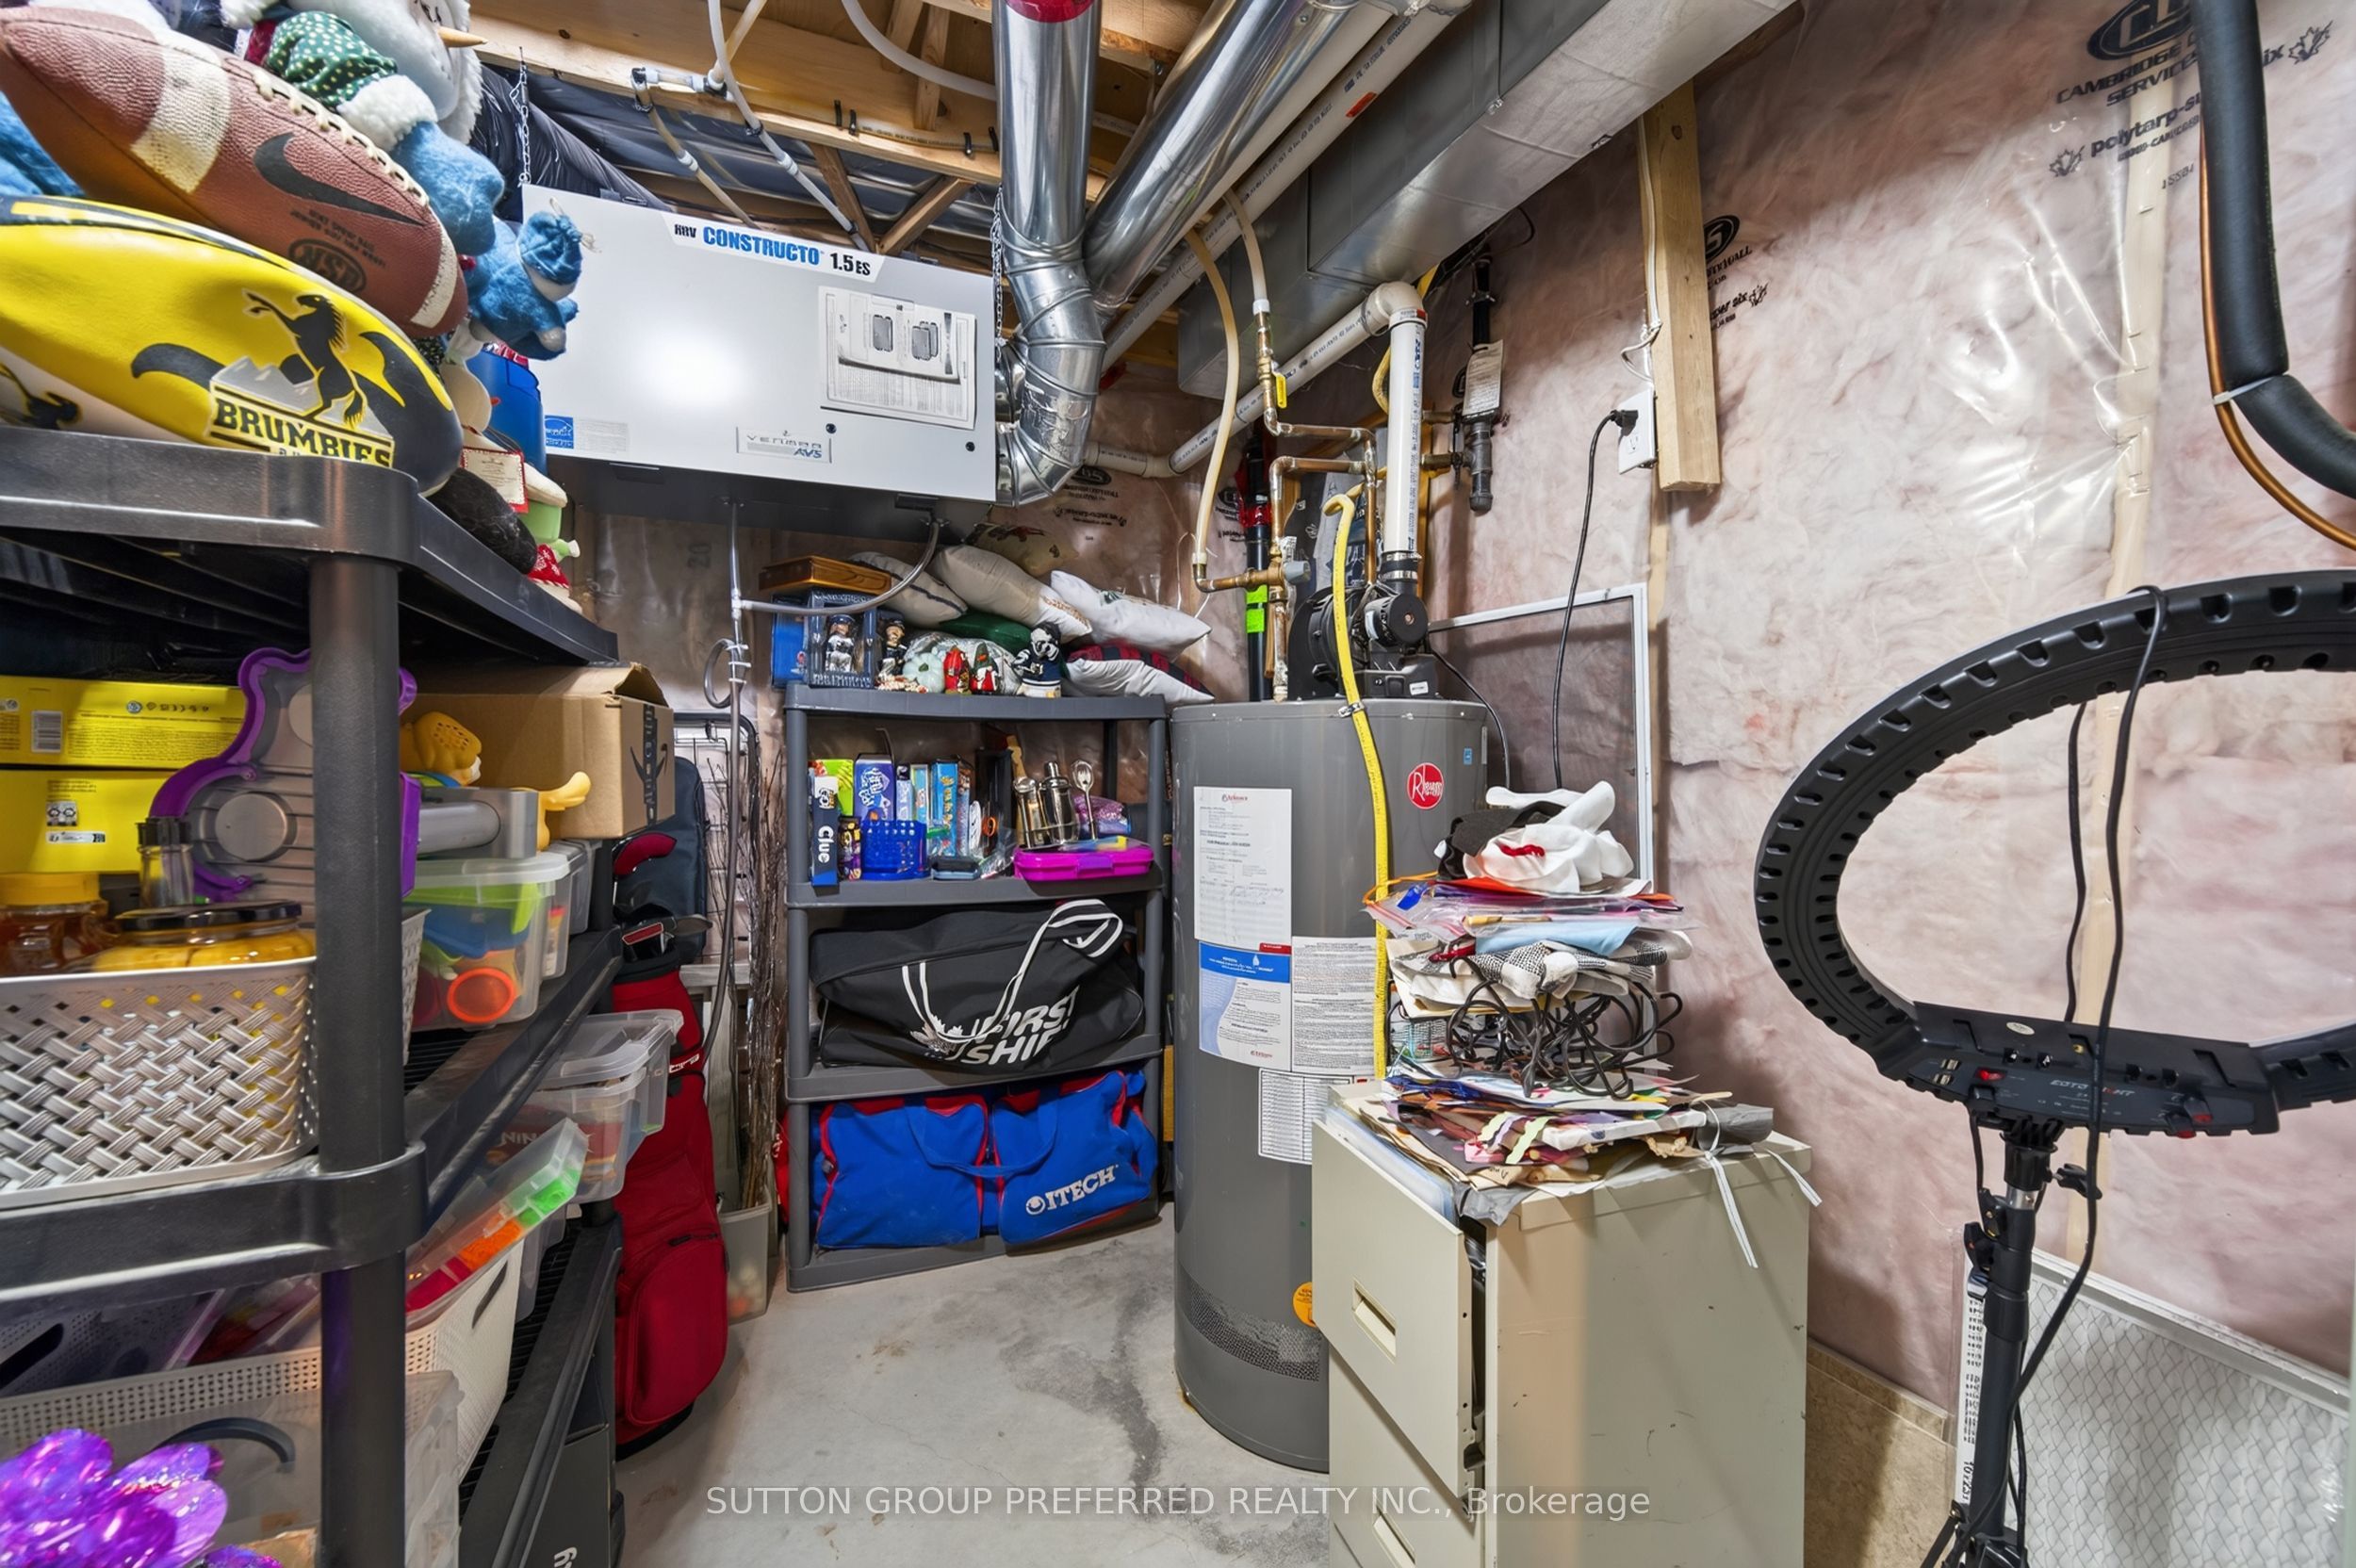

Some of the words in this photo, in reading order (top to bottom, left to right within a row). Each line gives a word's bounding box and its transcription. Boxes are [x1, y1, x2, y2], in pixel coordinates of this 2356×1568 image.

[2106, 51, 2199, 107] SERVICE
[674, 223, 696, 238] HRV
[702, 226, 820, 266] CONSTRUCTO
[215, 397, 391, 467] BRUMBIES
[794, 448, 823, 459] AVS
[817, 825, 835, 864] Clue
[1044, 1165, 1117, 1211] ITECH
